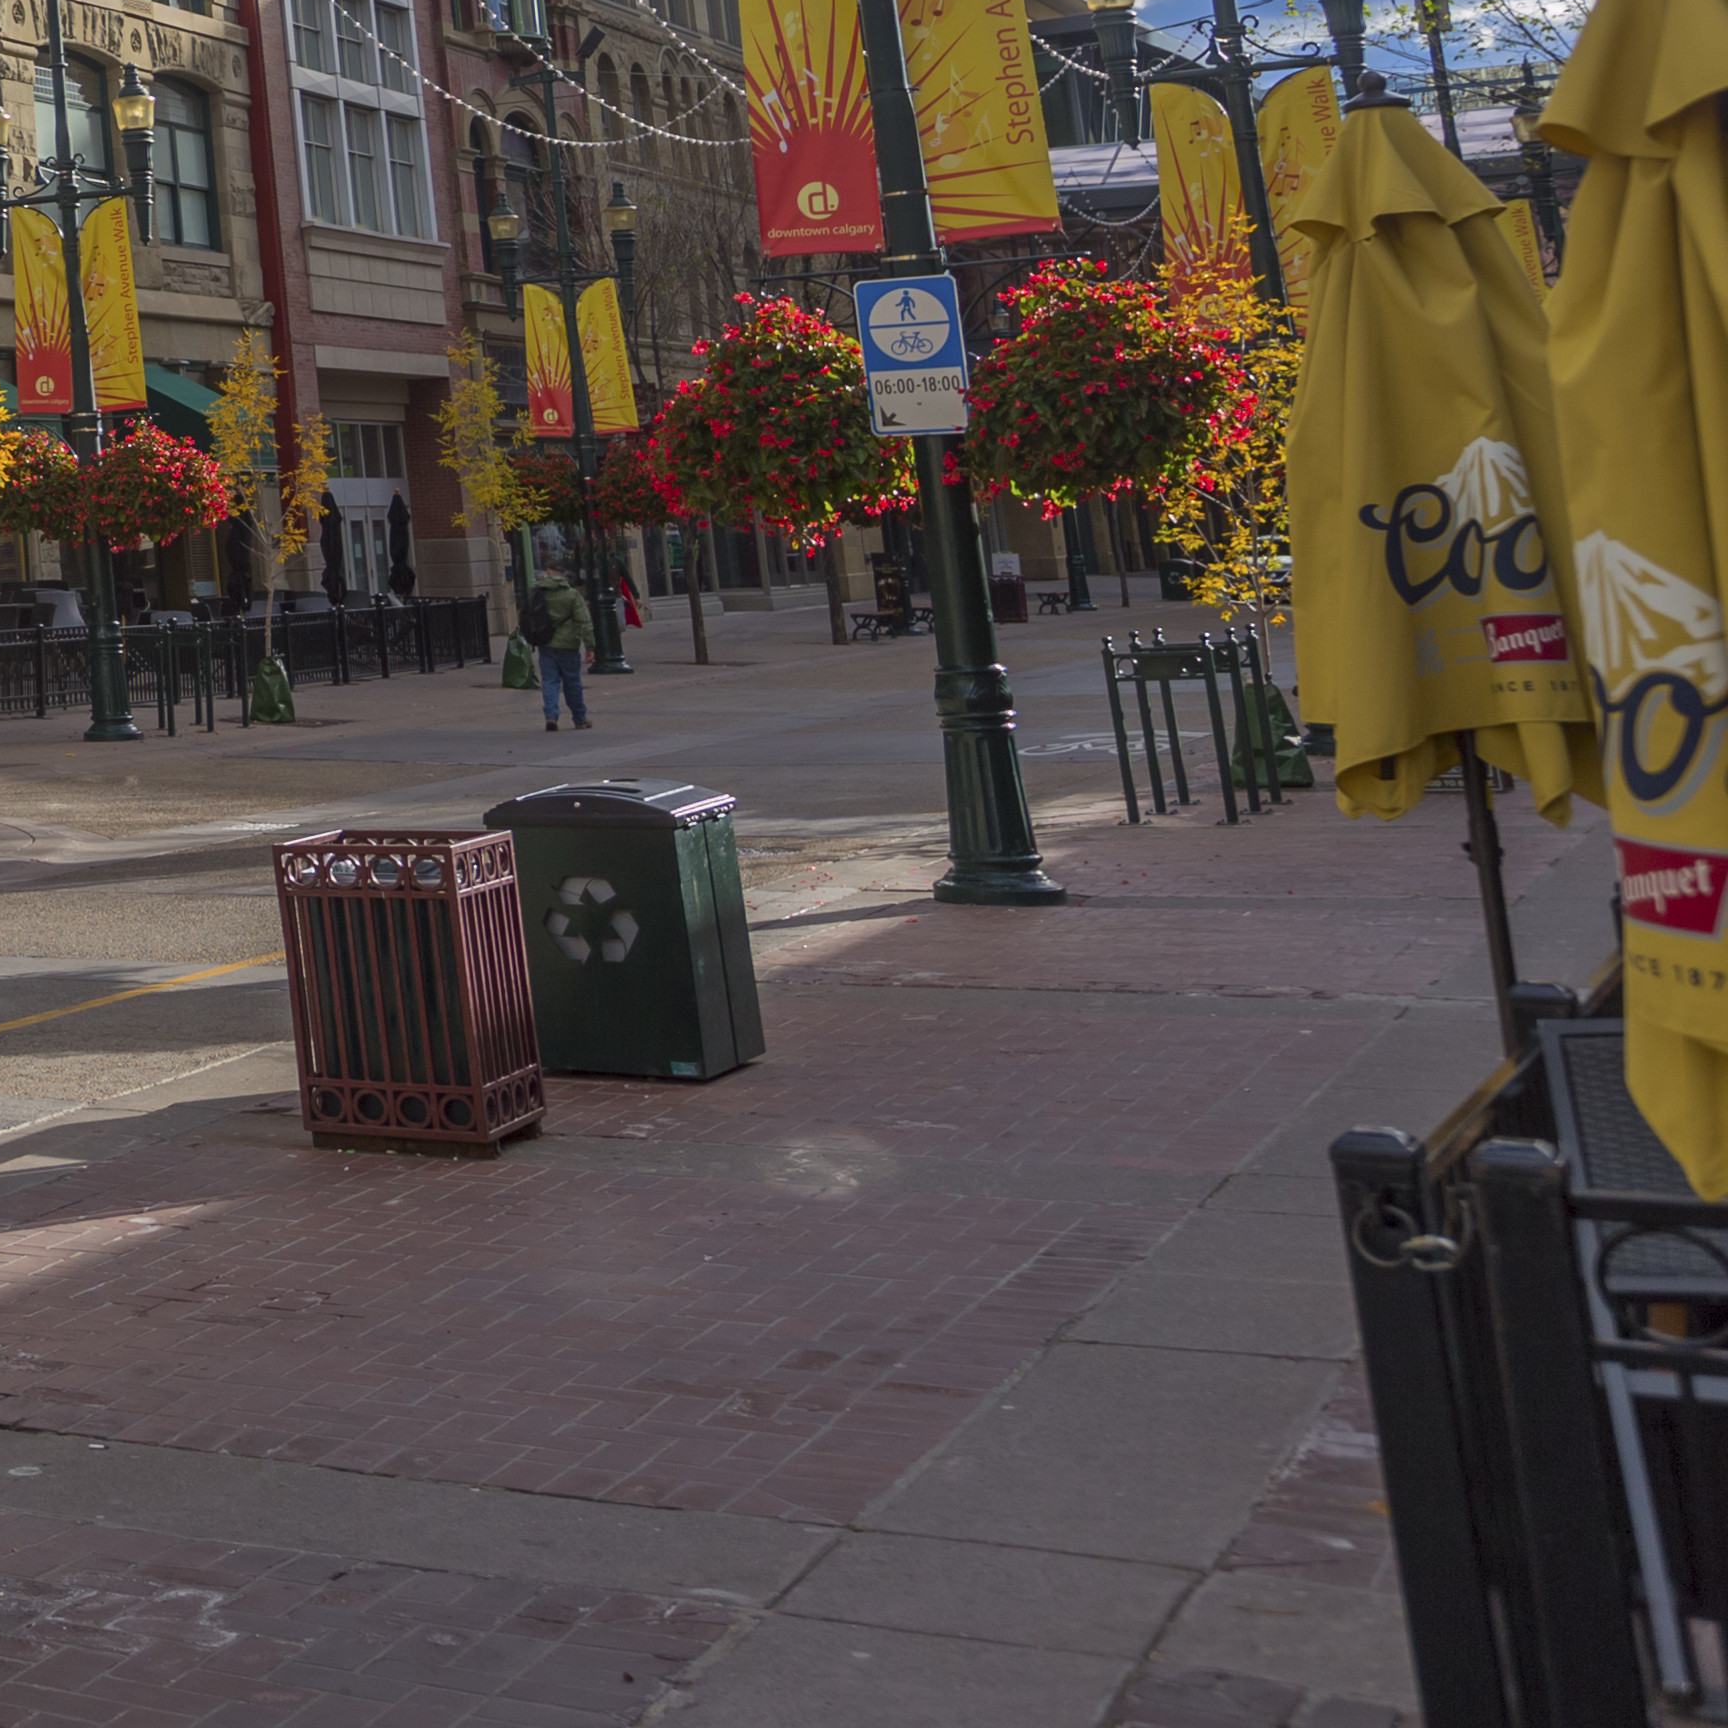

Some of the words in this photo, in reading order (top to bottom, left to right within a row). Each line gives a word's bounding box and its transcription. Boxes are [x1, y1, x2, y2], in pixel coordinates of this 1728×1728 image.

[995, 27, 1034, 145] Stephen
[1307, 77, 1330, 124] Walk
[111, 207, 127, 244] Walk
[767, 225, 829, 239] downtown
[832, 223, 876, 239] calgary
[119, 245, 132, 299] Avenue
[122, 303, 138, 365] Stephen
[608, 313, 622, 353] Avenue
[615, 355, 630, 400] Stephen
[875, 375, 960, 396] 06:00-18:00
